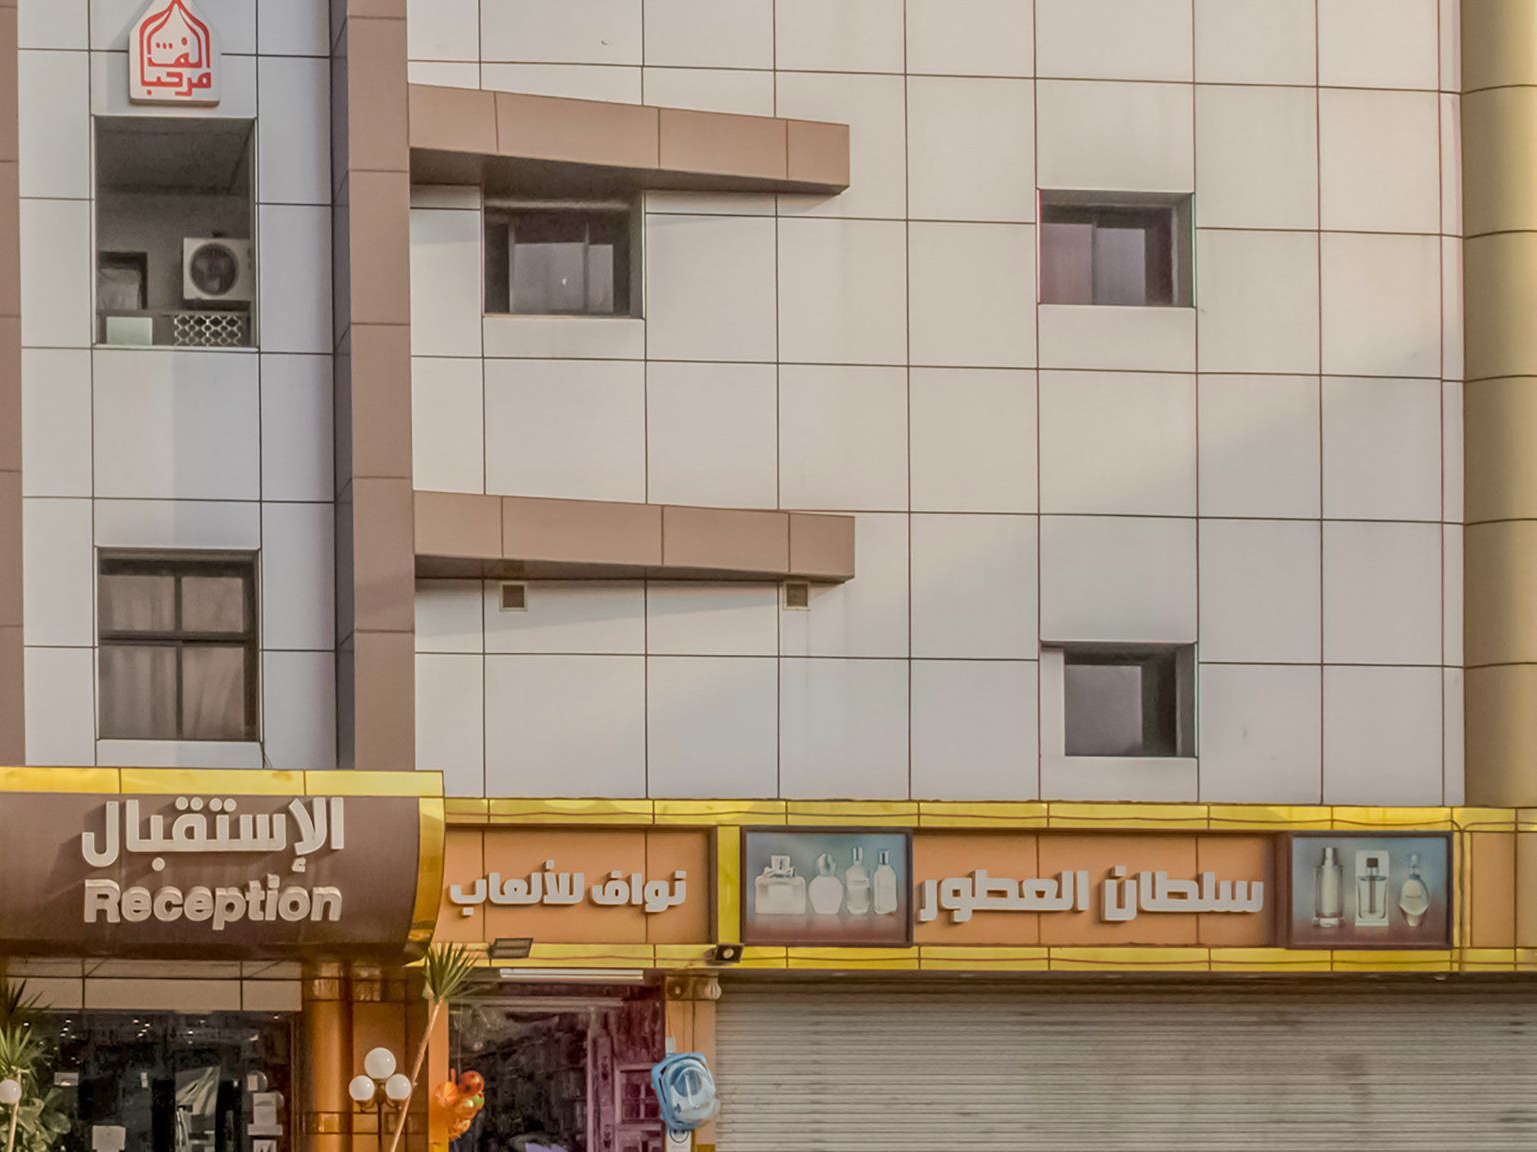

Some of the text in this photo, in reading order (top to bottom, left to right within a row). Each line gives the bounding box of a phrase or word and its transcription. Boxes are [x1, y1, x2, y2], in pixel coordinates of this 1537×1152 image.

[83, 874, 343, 930] Reception
[591, 869, 687, 913] نواف
[919, 865, 1264, 923] سلطان العطور
